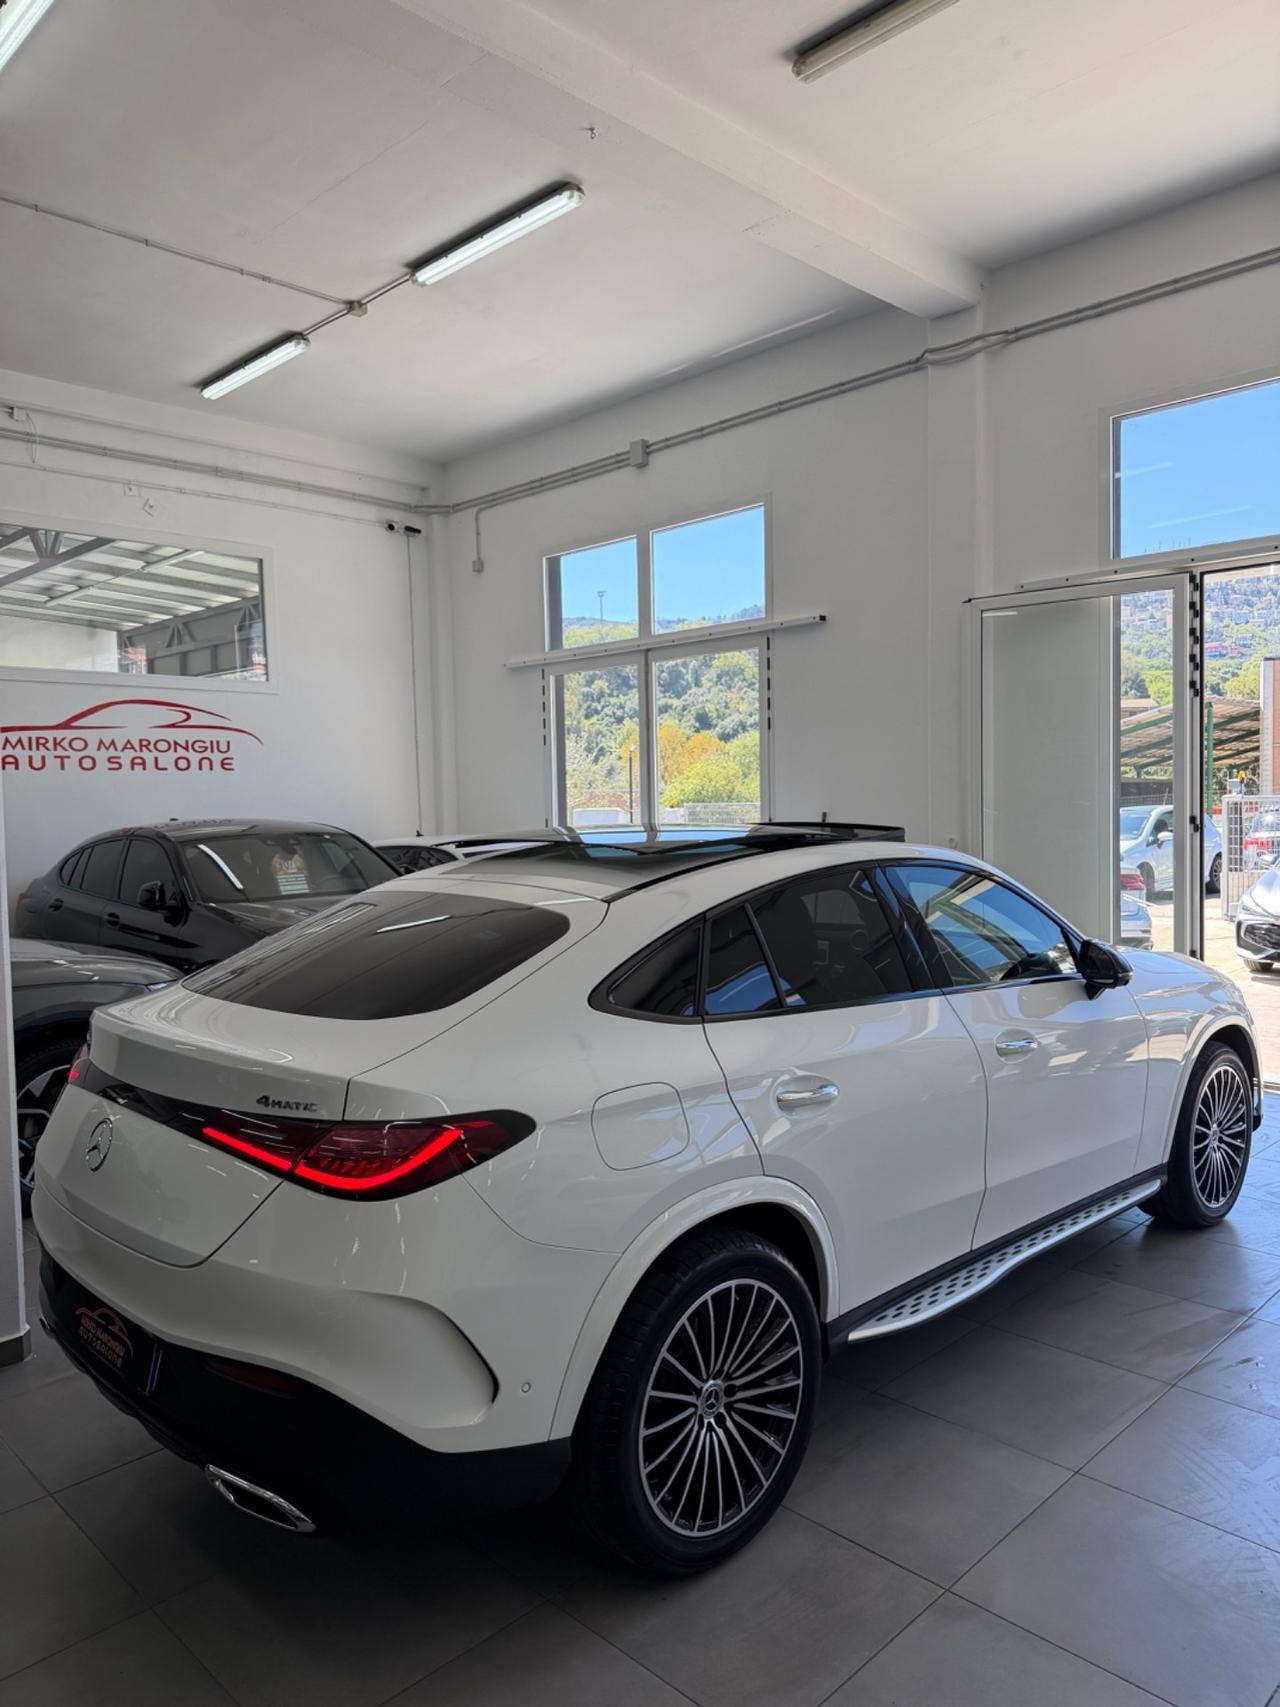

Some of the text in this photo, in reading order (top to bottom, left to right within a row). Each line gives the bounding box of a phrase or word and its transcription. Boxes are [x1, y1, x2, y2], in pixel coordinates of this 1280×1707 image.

[1, 736, 231, 753] MIRKO MARONGIU
[1, 754, 235, 771] AUTOSALONE
[256, 1095, 319, 1112] 4MATIC
